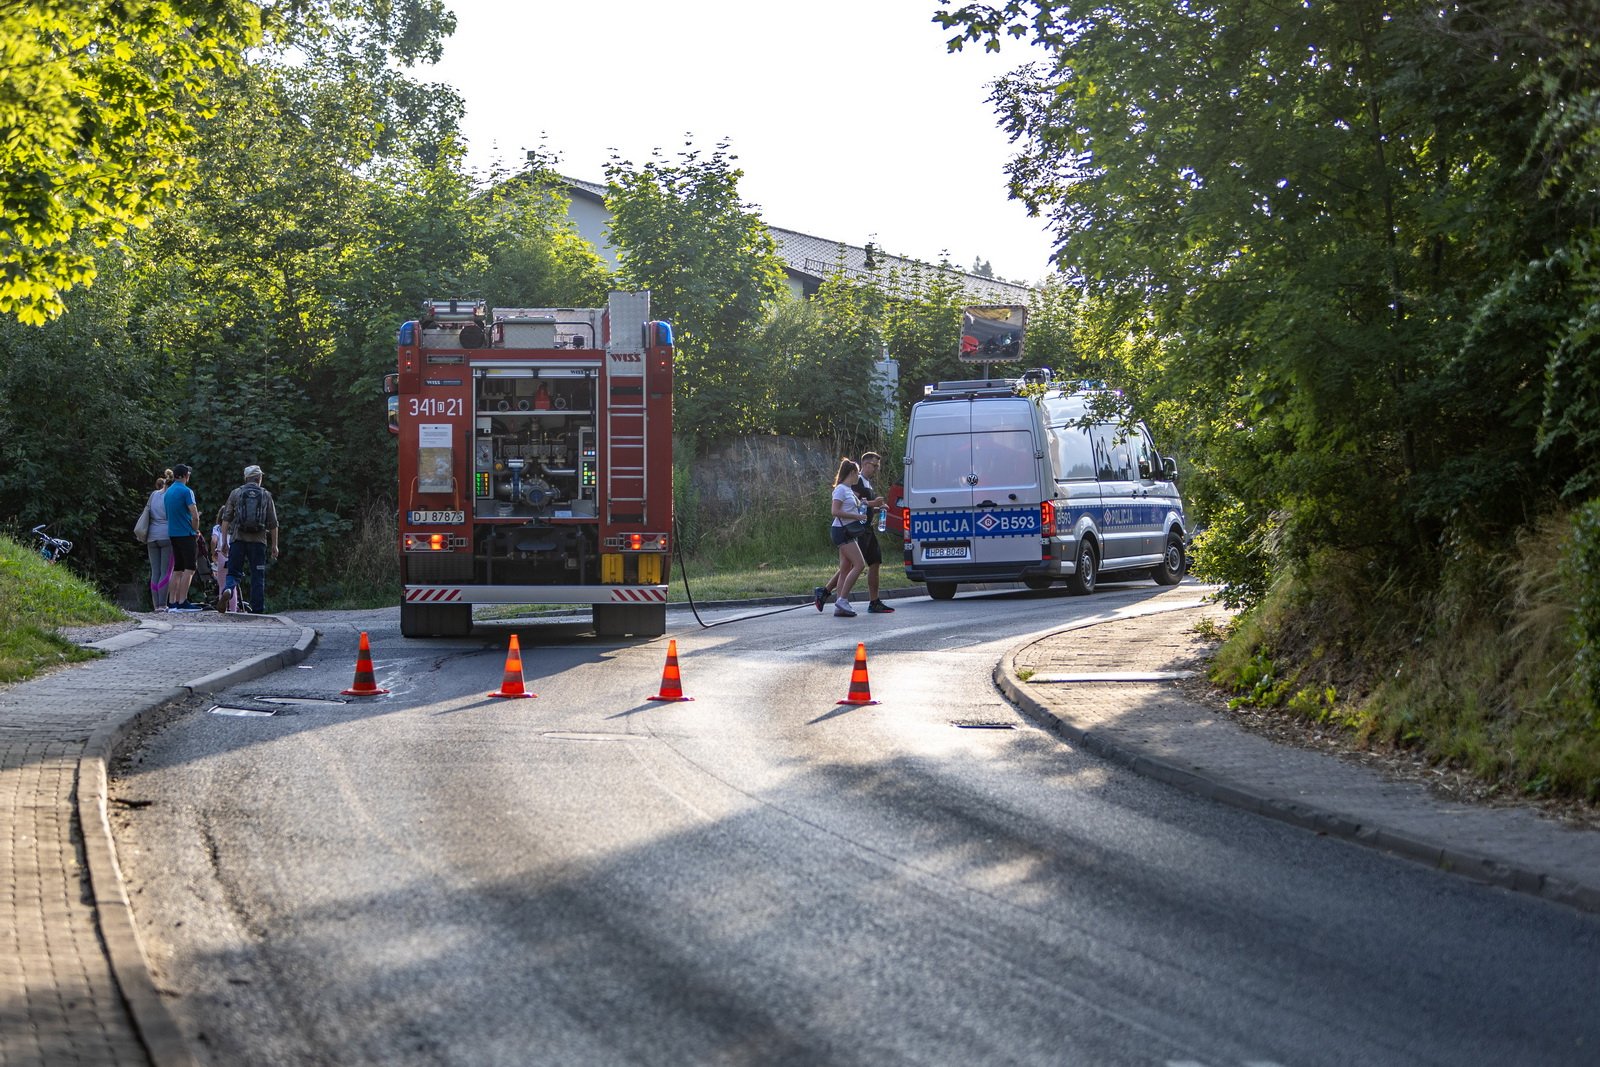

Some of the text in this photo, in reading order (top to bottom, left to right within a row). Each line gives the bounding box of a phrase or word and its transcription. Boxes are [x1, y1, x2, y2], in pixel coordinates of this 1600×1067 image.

[610, 354, 642, 362] WISS
[409, 398, 435, 416] 341
[447, 398, 463, 416] 21
[414, 512, 428, 521] DJ
[1057, 512, 1072, 525] B593
[1112, 509, 1134, 524] POLICJA
[914, 519, 970, 534] POLICJA
[1001, 516, 1035, 529] B593
